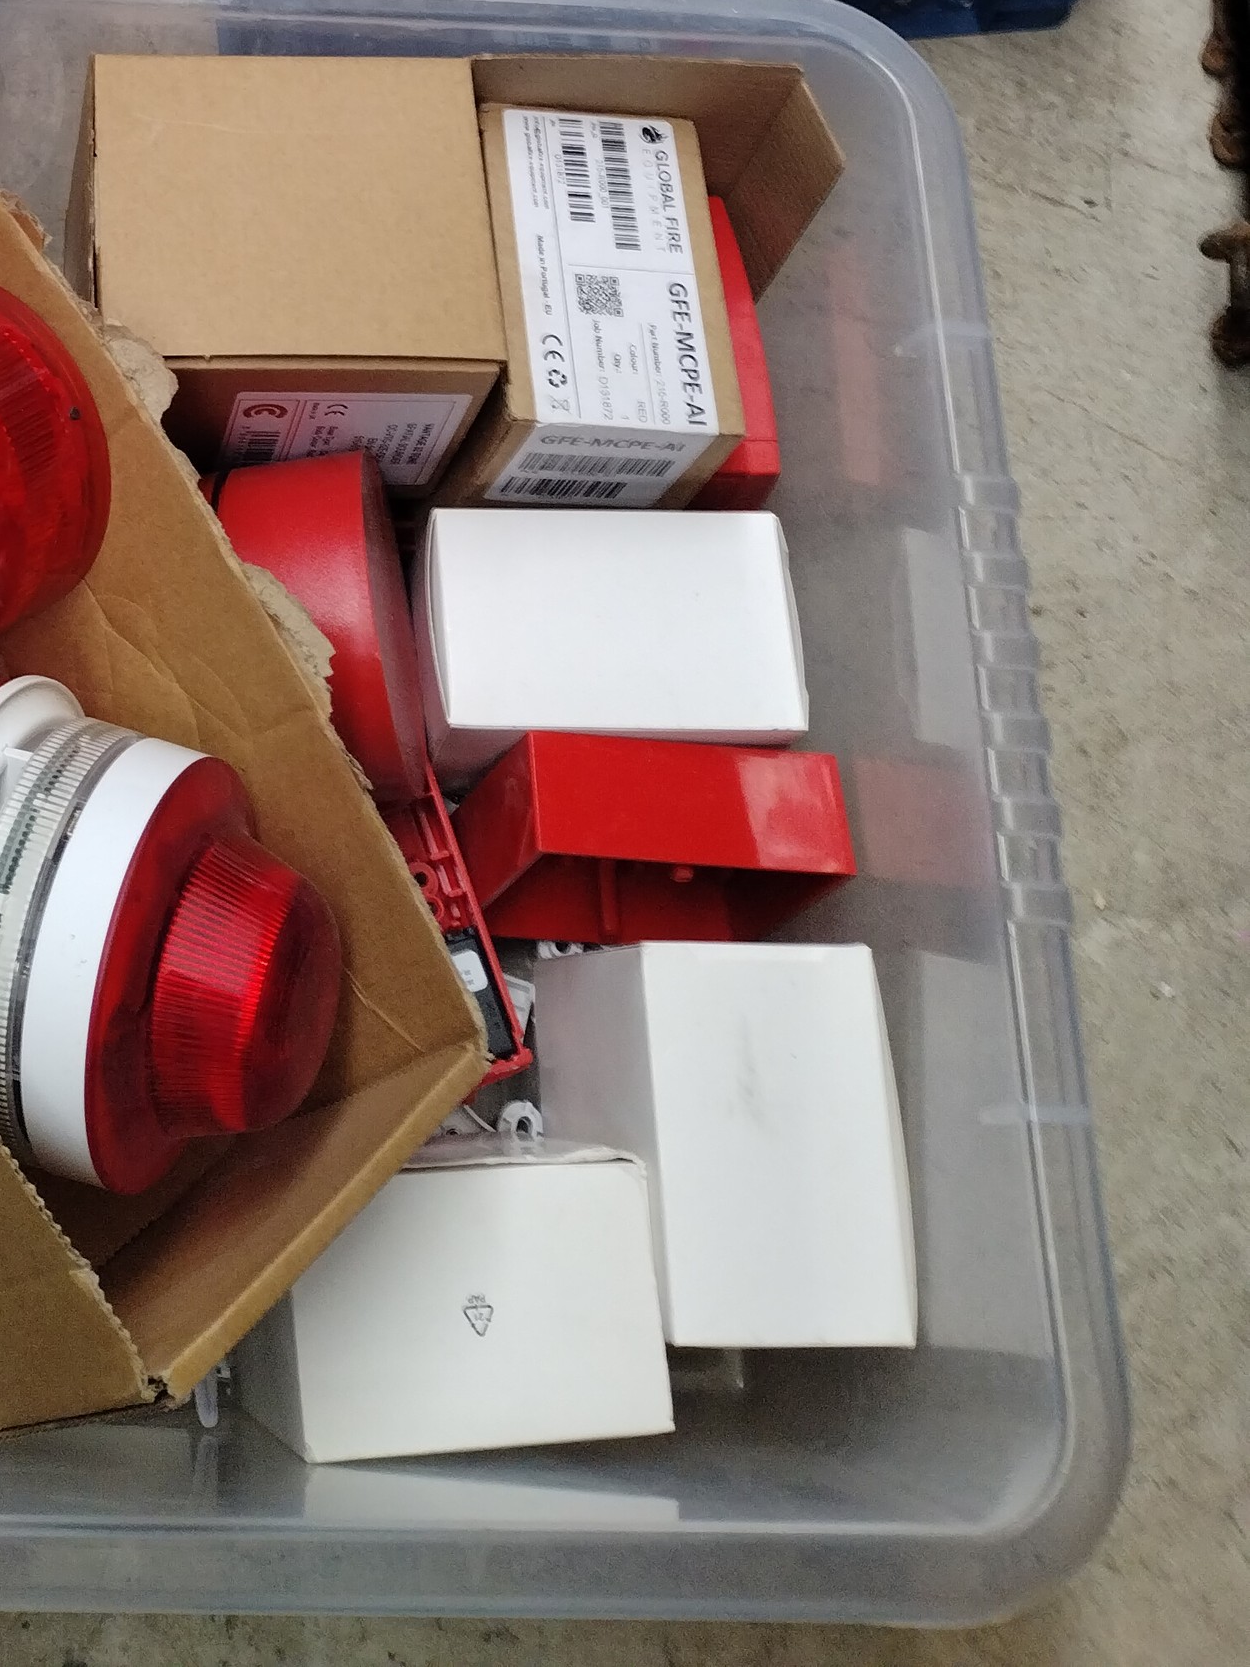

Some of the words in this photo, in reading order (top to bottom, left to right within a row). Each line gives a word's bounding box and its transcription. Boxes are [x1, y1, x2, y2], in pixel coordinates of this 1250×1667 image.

[654, 148, 676, 211] GLOBAL
[641, 147, 664, 254] EQUIPMENT
[535, 234, 545, 255] Made
[664, 216, 683, 255] FIRE
[538, 266, 551, 298] Portugal
[544, 303, 553, 315] EU
[592, 319, 601, 334] Job
[648, 324, 658, 341] Part
[594, 335, 606, 373] Number:
[651, 342, 663, 376] Number:
[667, 281, 708, 427] GFE-MCPE-AI
[628, 343, 640, 374] Colour:
[636, 400, 647, 423] RED
[540, 435, 686, 452] GFE-MCPE-AI
